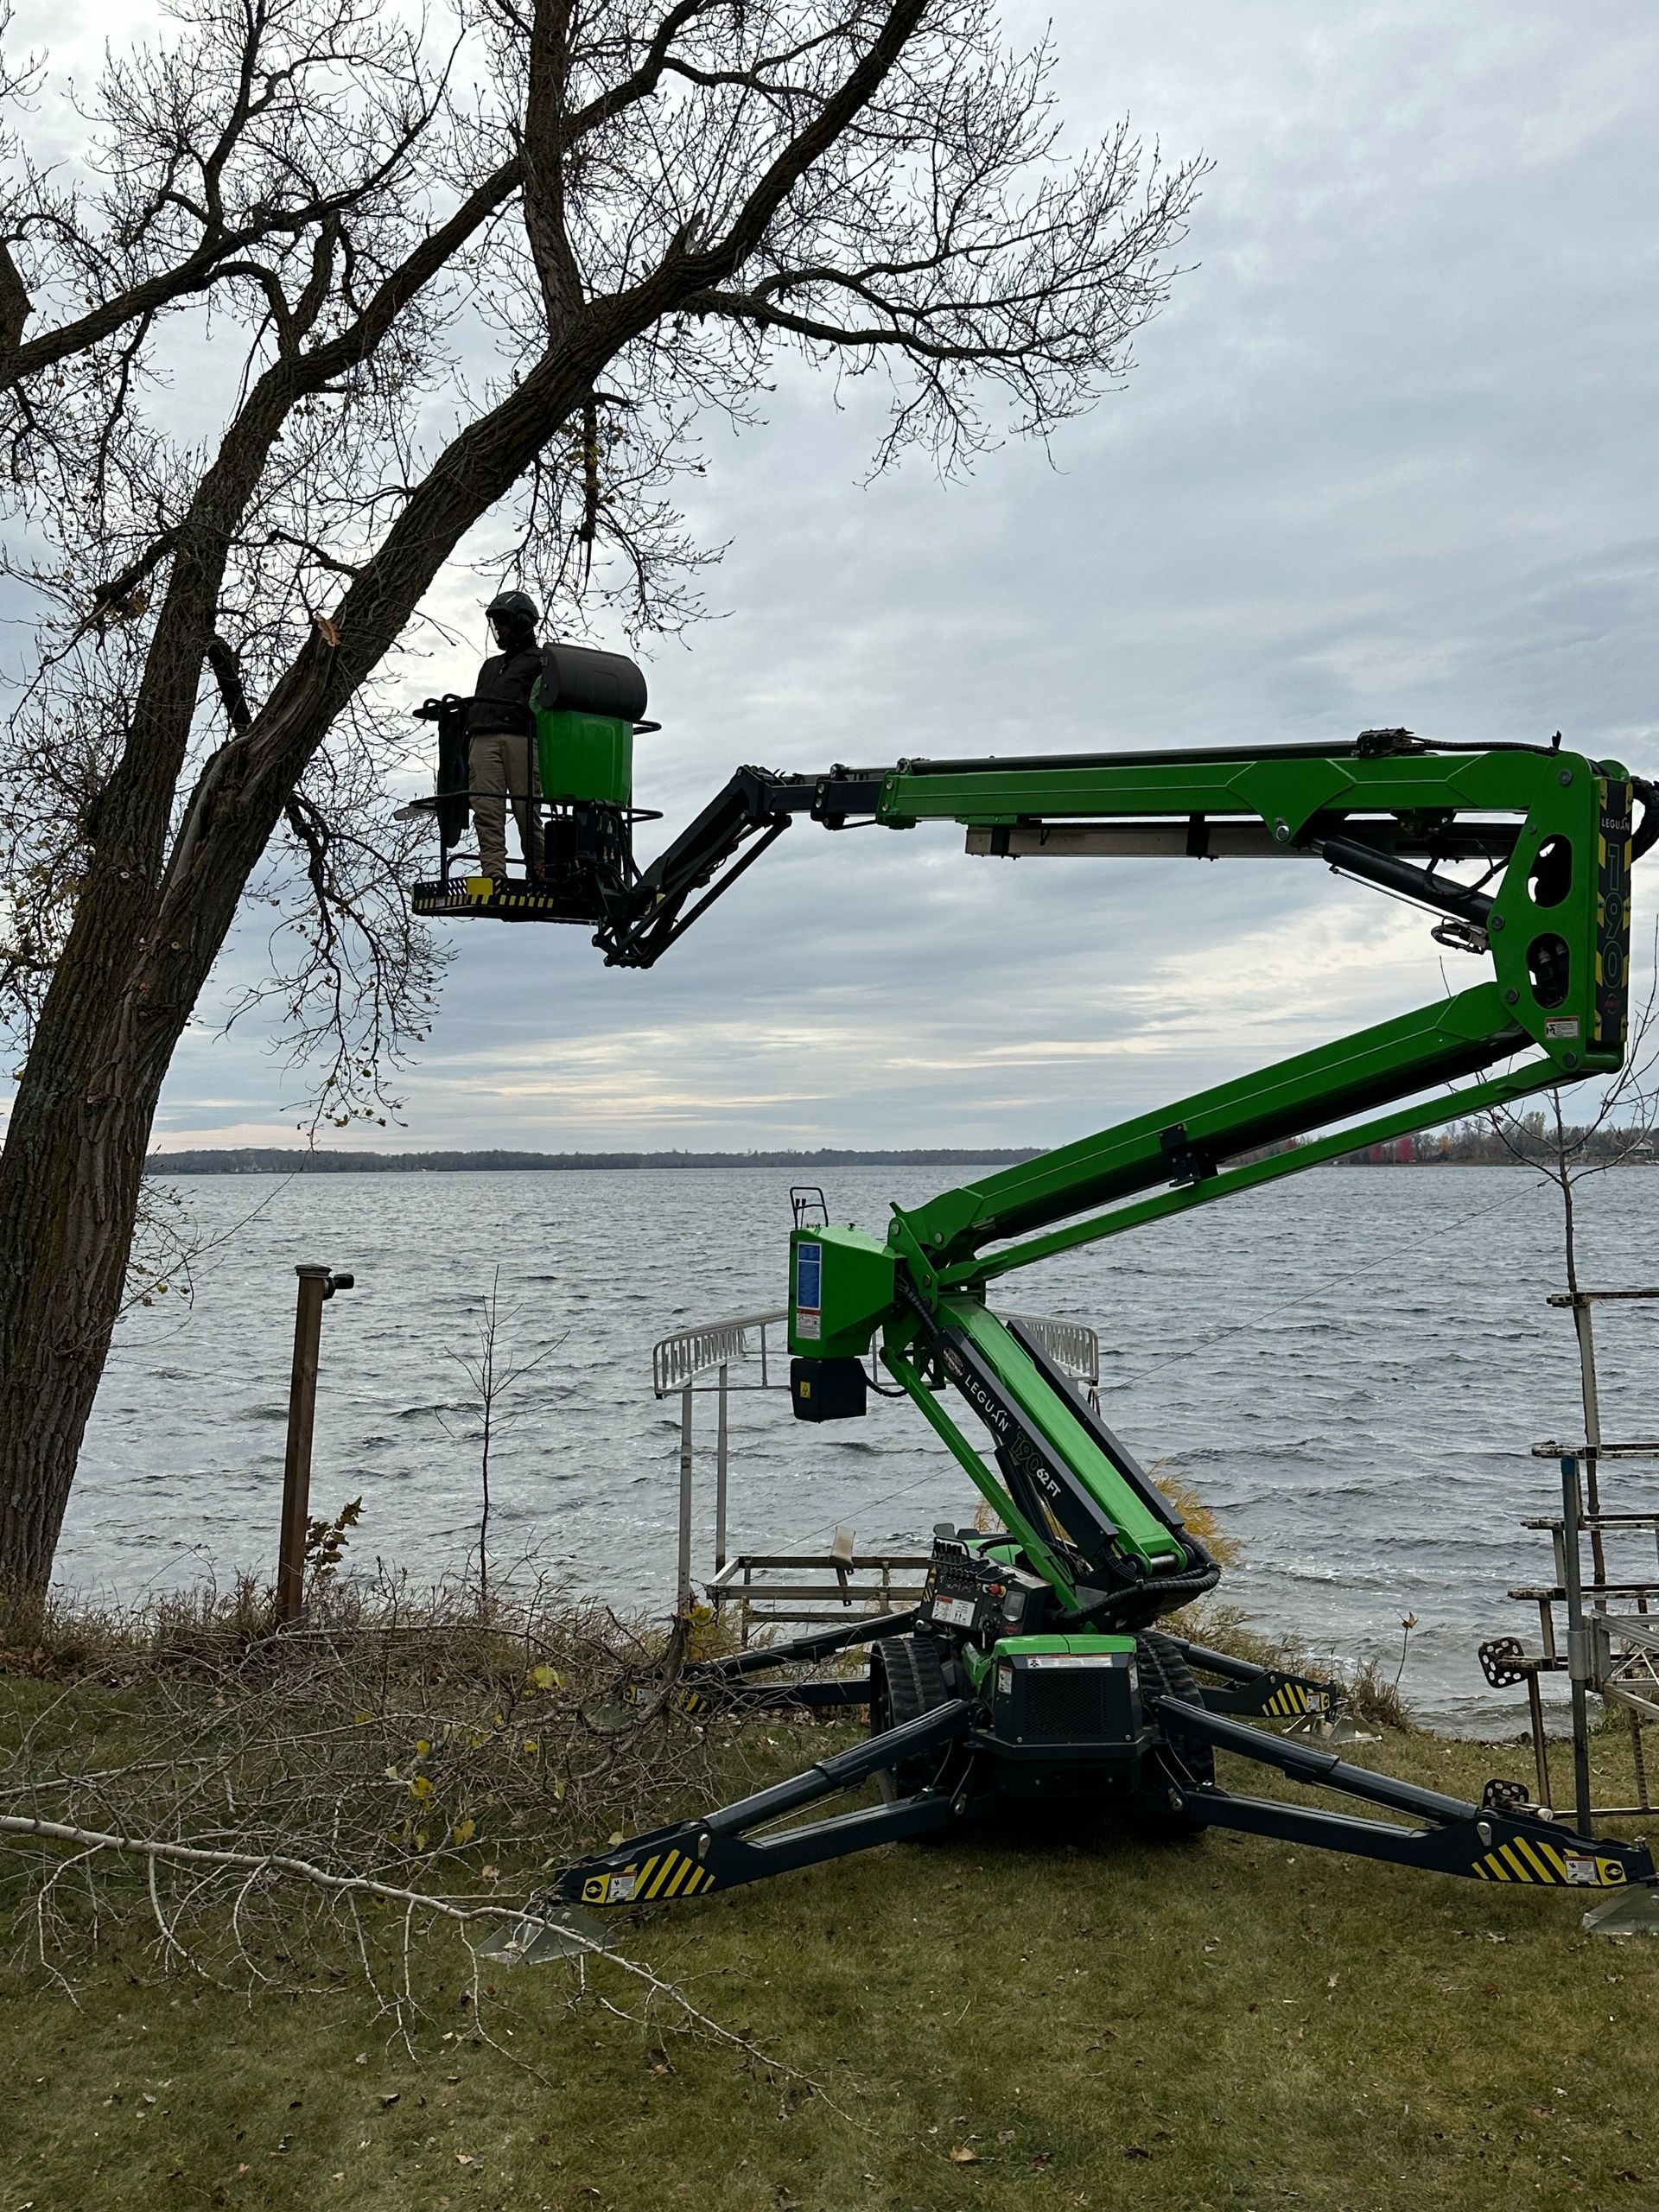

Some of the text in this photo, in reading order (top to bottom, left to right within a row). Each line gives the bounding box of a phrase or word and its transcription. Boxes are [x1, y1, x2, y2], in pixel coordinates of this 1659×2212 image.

[1601, 817, 1630, 831] LEGUAN
[964, 1374, 1009, 1432] LEGUAN
[1036, 1468, 1050, 1484] 62
[1046, 1479, 1061, 1497] FT
